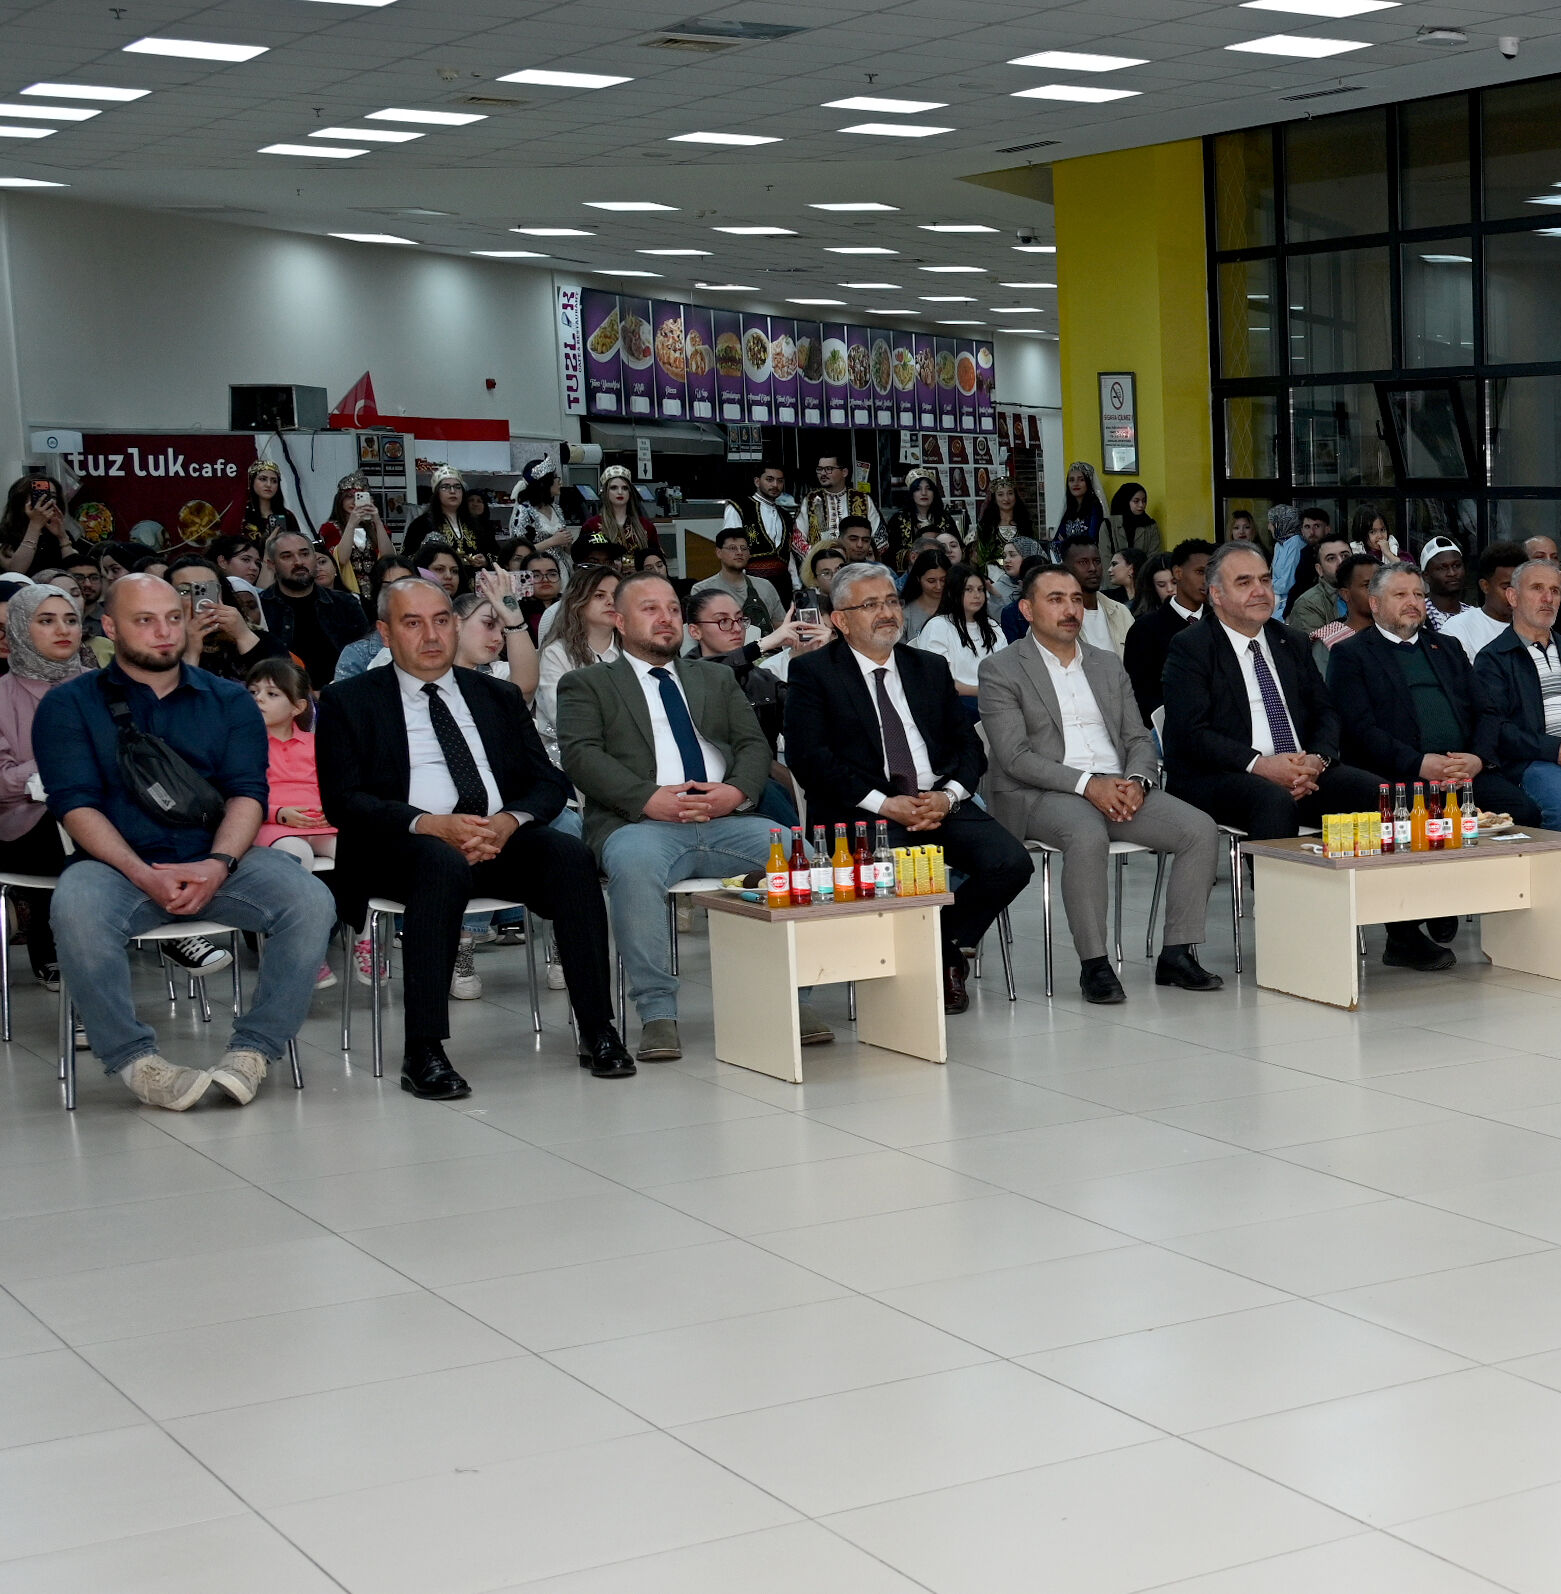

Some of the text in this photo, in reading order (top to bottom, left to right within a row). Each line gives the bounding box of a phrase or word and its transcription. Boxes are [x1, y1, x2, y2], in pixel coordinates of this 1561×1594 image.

[562, 291, 580, 410] TUZLK
[67, 447, 238, 478] tuzluk cafe
